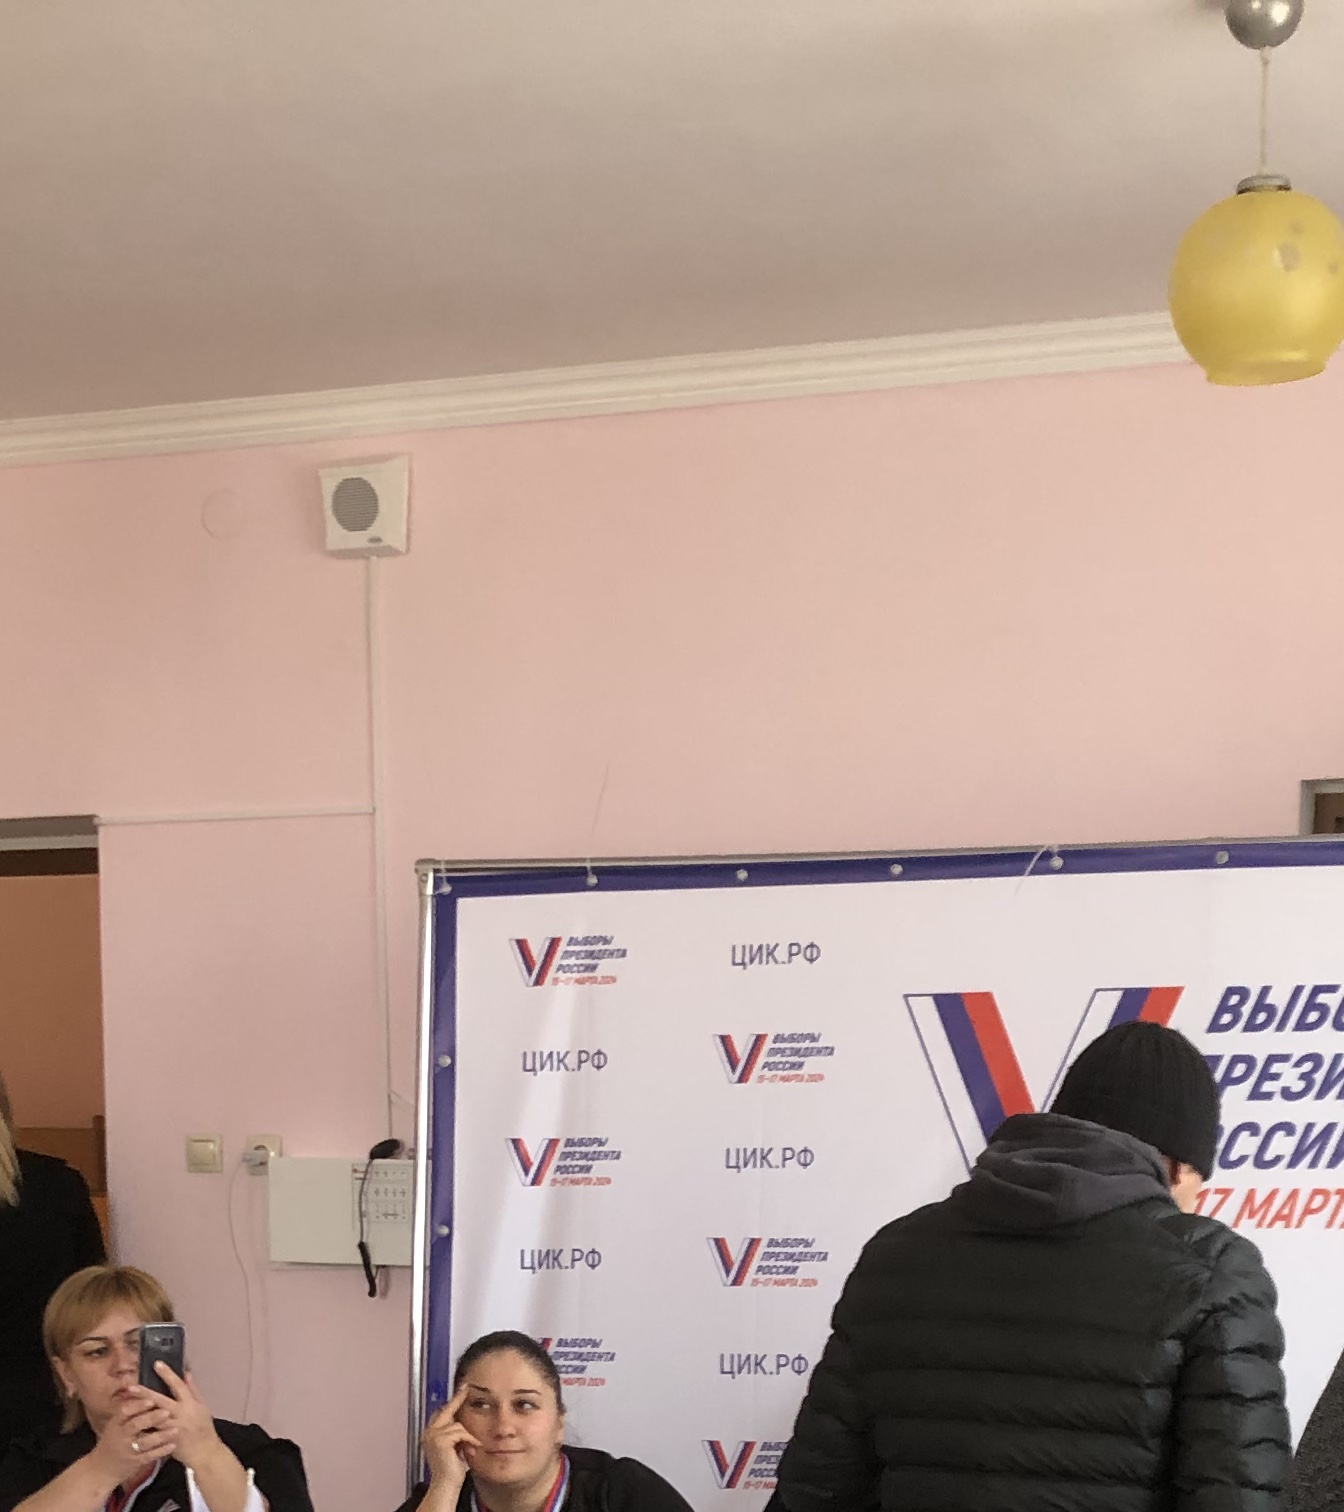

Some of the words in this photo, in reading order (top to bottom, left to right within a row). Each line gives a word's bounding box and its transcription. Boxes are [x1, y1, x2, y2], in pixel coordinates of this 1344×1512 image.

[731, 942, 821, 969] ЦИК.РФ
[522, 1049, 608, 1076] ЦИК.РФ
[564, 1137, 609, 1148] ВЫБОРЫ
[558, 1150, 622, 1162] ПРЕЗИДЕНТА
[724, 1147, 815, 1173] ЦИК.РФ
[554, 1164, 593, 1175] РОССИИ
[766, 1237, 816, 1248] ВЫБОРЫ
[519, 1247, 602, 1274] ЦИК.РФ
[760, 1251, 829, 1263] ПРЕЗИДЕНТА
[754, 1265, 800, 1275] РОССИИ
[556, 1337, 603, 1349] ВЫБОРЫ
[719, 1353, 809, 1379] ЦИК.РФ
